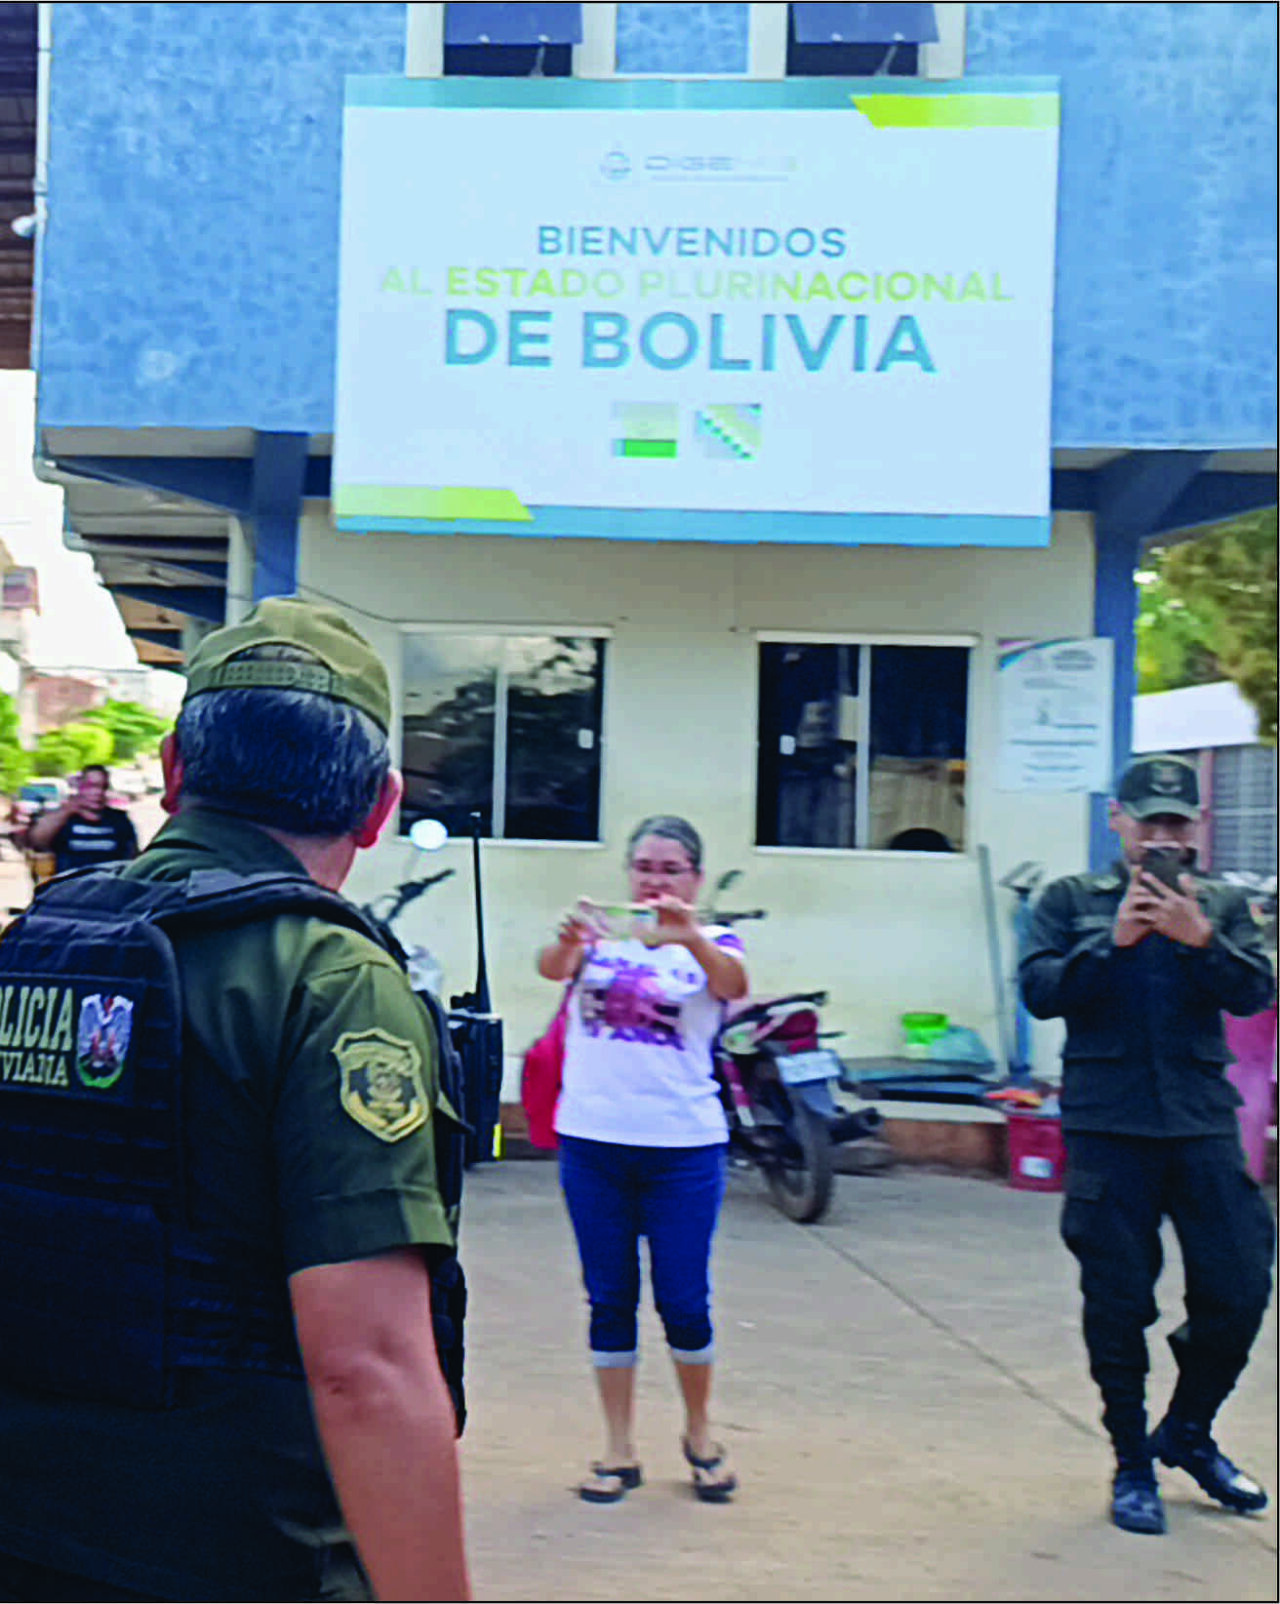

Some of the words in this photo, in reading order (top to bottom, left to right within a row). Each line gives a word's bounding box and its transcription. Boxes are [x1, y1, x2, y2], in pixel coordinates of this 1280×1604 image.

[539, 226, 847, 258] BIENVENIDOS
[380, 267, 432, 296] AL
[447, 267, 624, 298] ESTADO
[639, 271, 1014, 302] PLURINACIONAL
[445, 308, 553, 367] DE
[581, 311, 937, 372] BOLIVIA
